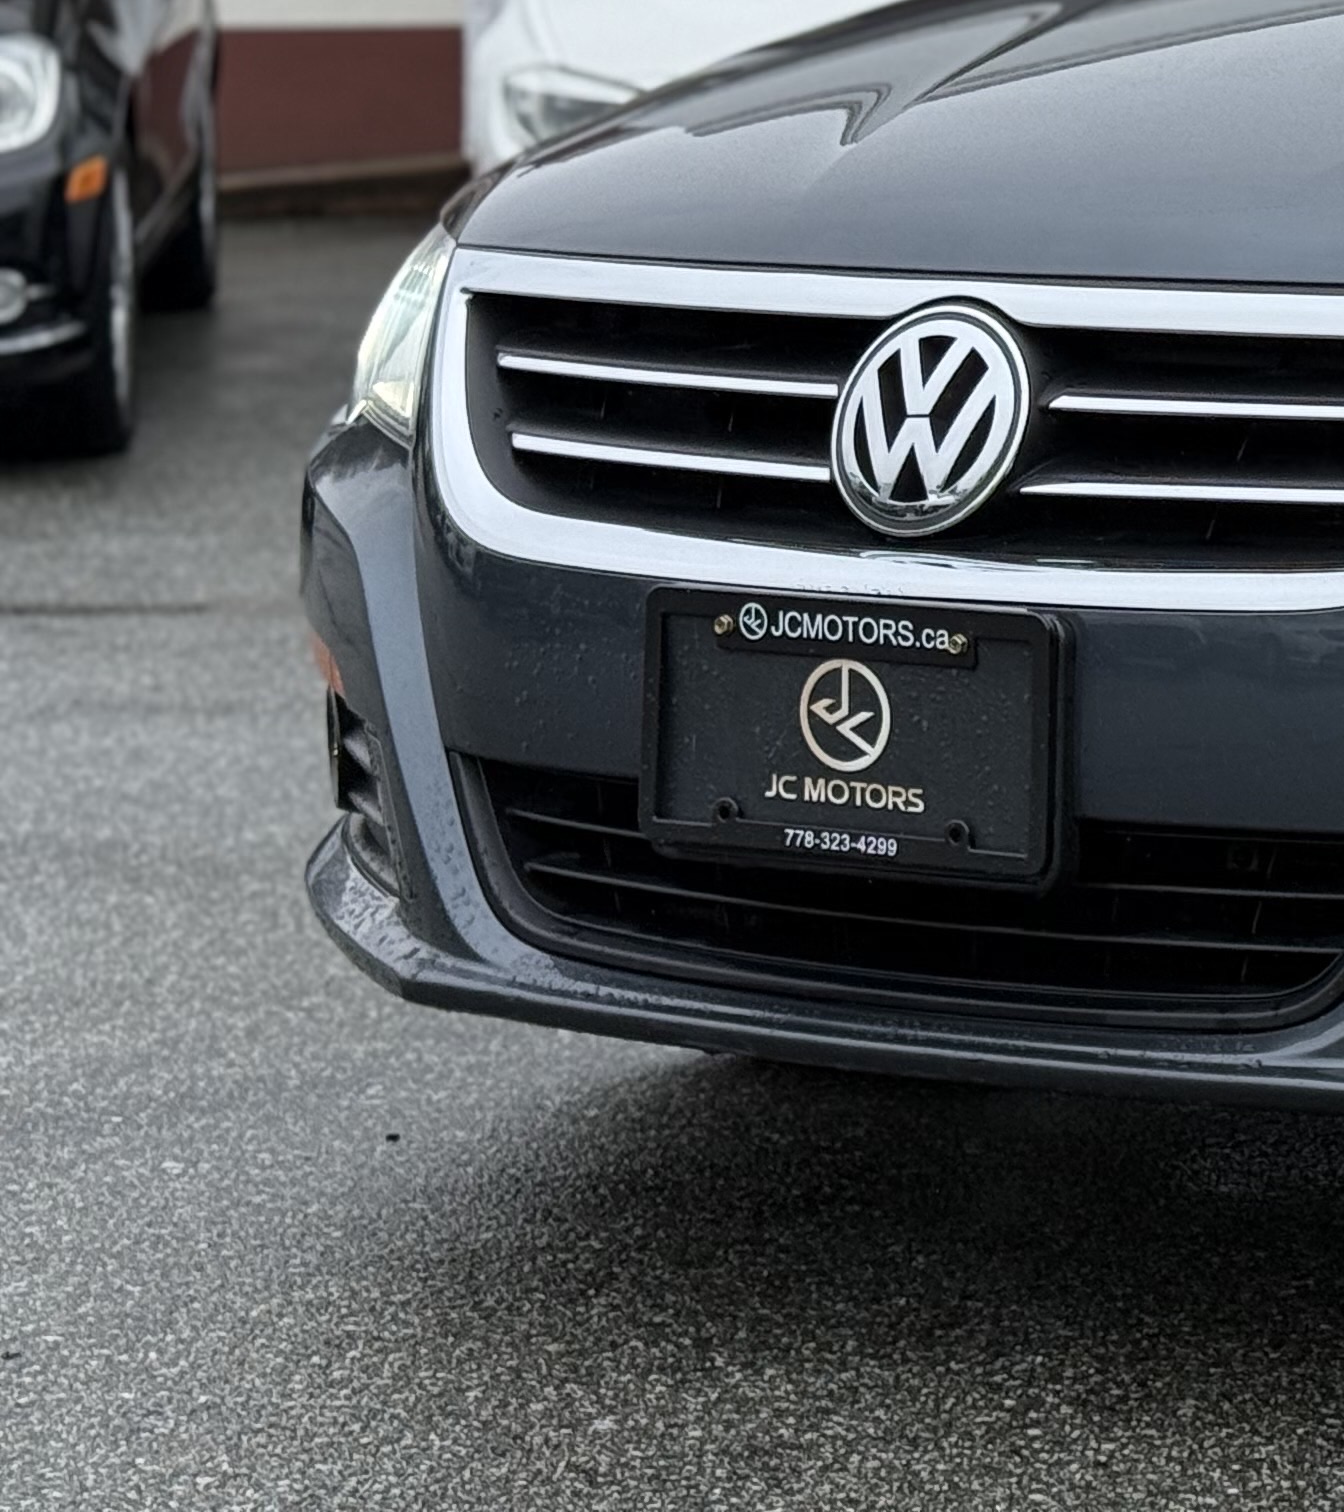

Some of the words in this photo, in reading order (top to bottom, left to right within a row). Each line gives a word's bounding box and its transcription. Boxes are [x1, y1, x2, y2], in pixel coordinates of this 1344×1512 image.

[770, 610, 950, 651] JCMOTORS.ca
[764, 773, 799, 801] JC
[803, 776, 926, 814] MOTORS
[783, 827, 899, 858] 778-323-4299
